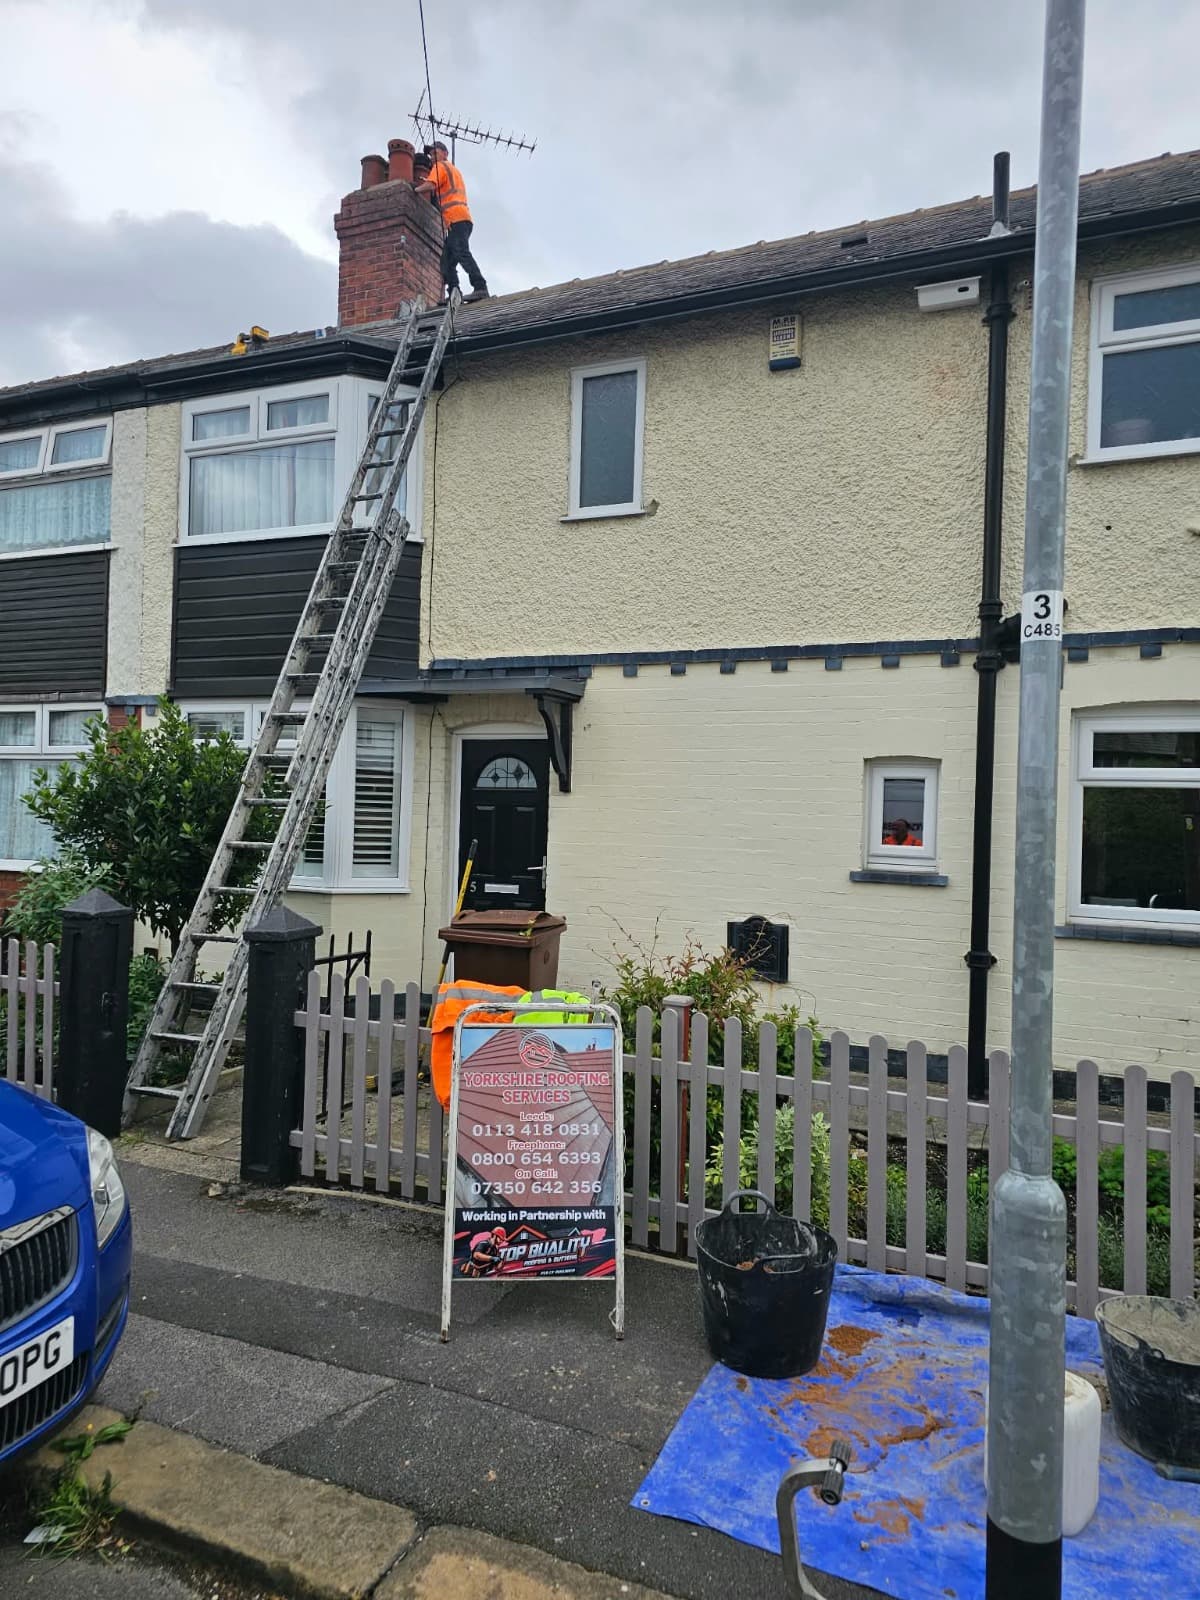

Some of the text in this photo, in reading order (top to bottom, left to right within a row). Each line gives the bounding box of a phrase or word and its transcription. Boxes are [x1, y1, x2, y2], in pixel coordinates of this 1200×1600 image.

[1033, 594, 1051, 620] 3
[1024, 623, 1061, 638] C485
[463, 1072, 609, 1087] YORKSHIRE ROOFING
[502, 1089, 571, 1104] SERVICES
[472, 1123, 600, 1137] 0113 418 0831
[471, 1151, 601, 1165] 0800 654 6393
[514, 1169, 531, 1179] On
[471, 1180, 602, 1195] 07350 642 356
[462, 1208, 606, 1223] Working in Partnership with
[498, 1236, 590, 1261] TOP QUALITY
[0, 1330, 61, 1396] OPG
